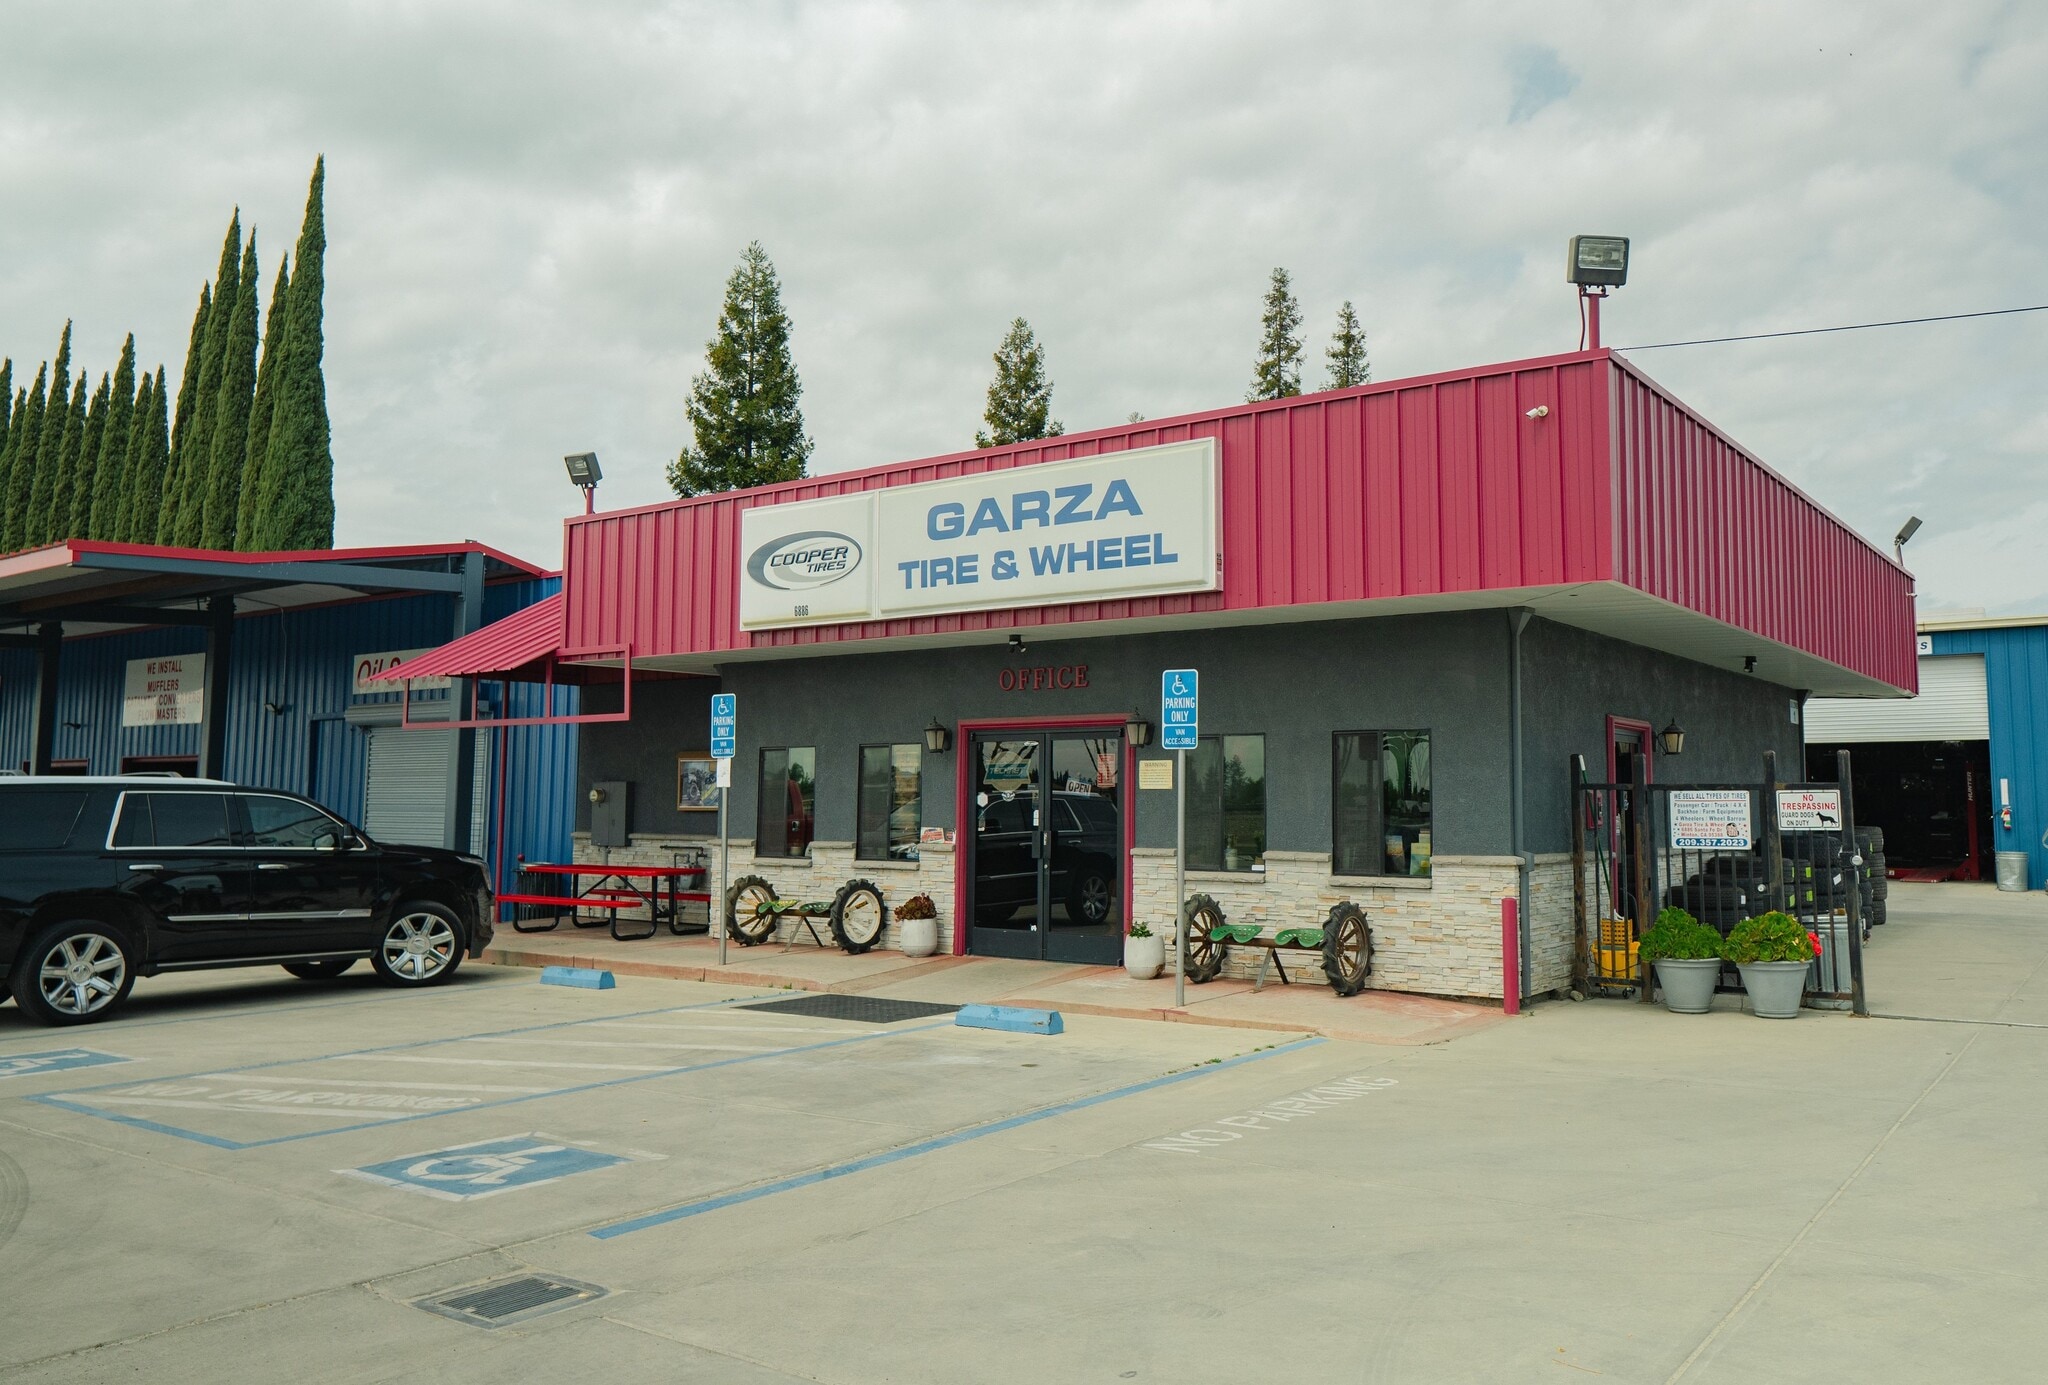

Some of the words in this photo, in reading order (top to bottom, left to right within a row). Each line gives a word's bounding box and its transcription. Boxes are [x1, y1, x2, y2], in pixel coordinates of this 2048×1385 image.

[927, 478, 1144, 541] GARZA
[770, 545, 849, 567] COOPER
[898, 554, 979, 590] TIRE
[991, 549, 1020, 581] &
[1028, 532, 1179, 577] WHEEL
[806, 560, 847, 573] TIRES
[794, 604, 809, 617] 6886
[147, 662, 156, 675] WE
[158, 660, 183, 674] INSTALL
[999, 665, 1089, 691] OFFICE
[147, 679, 180, 693] MUFFLERS
[1165, 697, 1195, 709] PARKING
[713, 715, 734, 726] PARKING
[1171, 710, 1189, 722] ONLY
[717, 727, 729, 737] ONLY
[1175, 728, 1185, 736] VAN
[1068, 781, 1092, 795] OPEN
[1781, 802, 1836, 810] TRESPASSING
[1679, 838, 1745, 846] 209.357.2023
[1132, 1128, 1243, 1154] NO
[1215, 1075, 1400, 1130] PARKING
